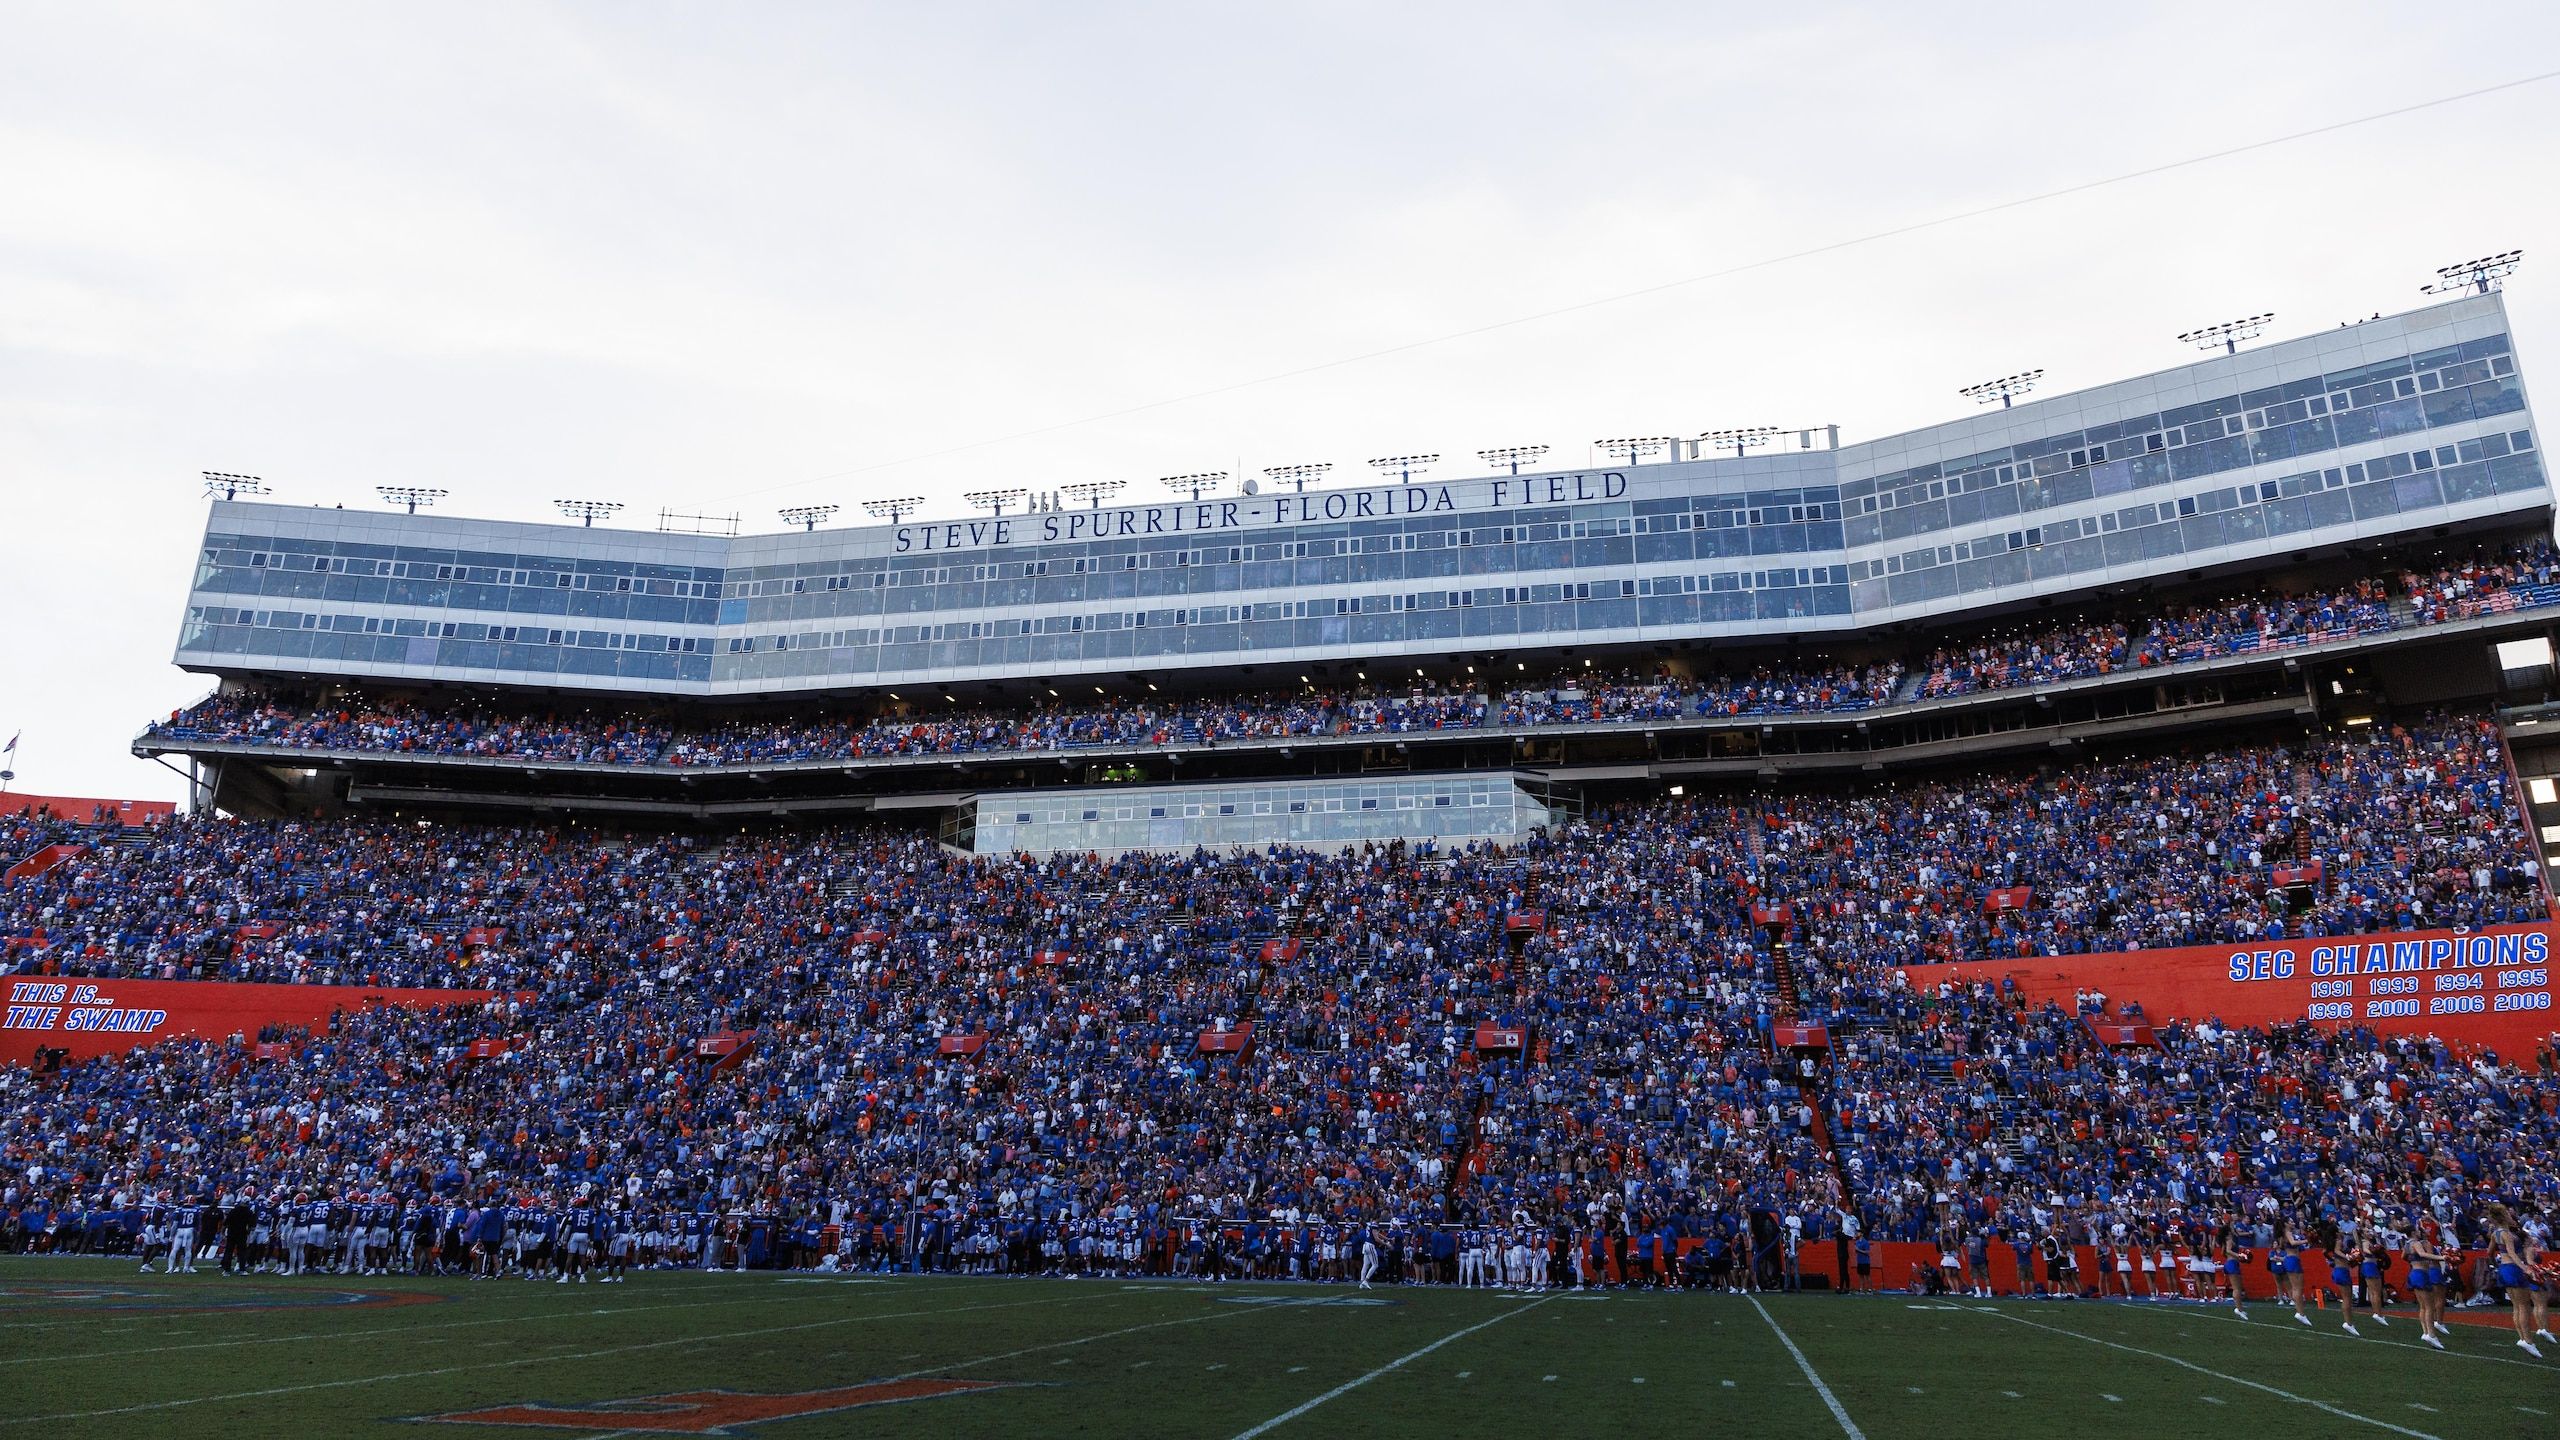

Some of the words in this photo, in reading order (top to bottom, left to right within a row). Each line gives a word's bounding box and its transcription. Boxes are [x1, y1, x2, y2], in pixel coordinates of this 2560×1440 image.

[896, 519, 1011, 552] STEVE
[1491, 472, 1627, 507] FIELD
[2229, 949, 2296, 982] SEC
[2310, 932, 2549, 978] CHAMPIONS
[2311, 980, 2353, 1000] 1991
[2370, 975, 2419, 996] 1993
[2435, 973, 2484, 993] 1994
[2498, 968, 2548, 989] 1995
[9, 983, 68, 1003] THIS
[70, 985, 115, 1006] IS...
[2308, 1002, 2353, 1021] 1996
[2367, 999, 2420, 1019] 2000
[2430, 995, 2485, 1016] 2006
[2494, 991, 2552, 1012] 2008
[2, 1005, 63, 1030] THE
[64, 1007, 168, 1033] SWAMP
[181, 1212, 195, 1225] 18
[314, 1206, 330, 1219] 96
[379, 1210, 393, 1222] 34
[507, 1210, 521, 1221] 88
[535, 1213, 548, 1224] 93
[577, 1212, 590, 1227] 15
[1105, 1226, 1116, 1237] 26
[1470, 1233, 1481, 1246] 41
